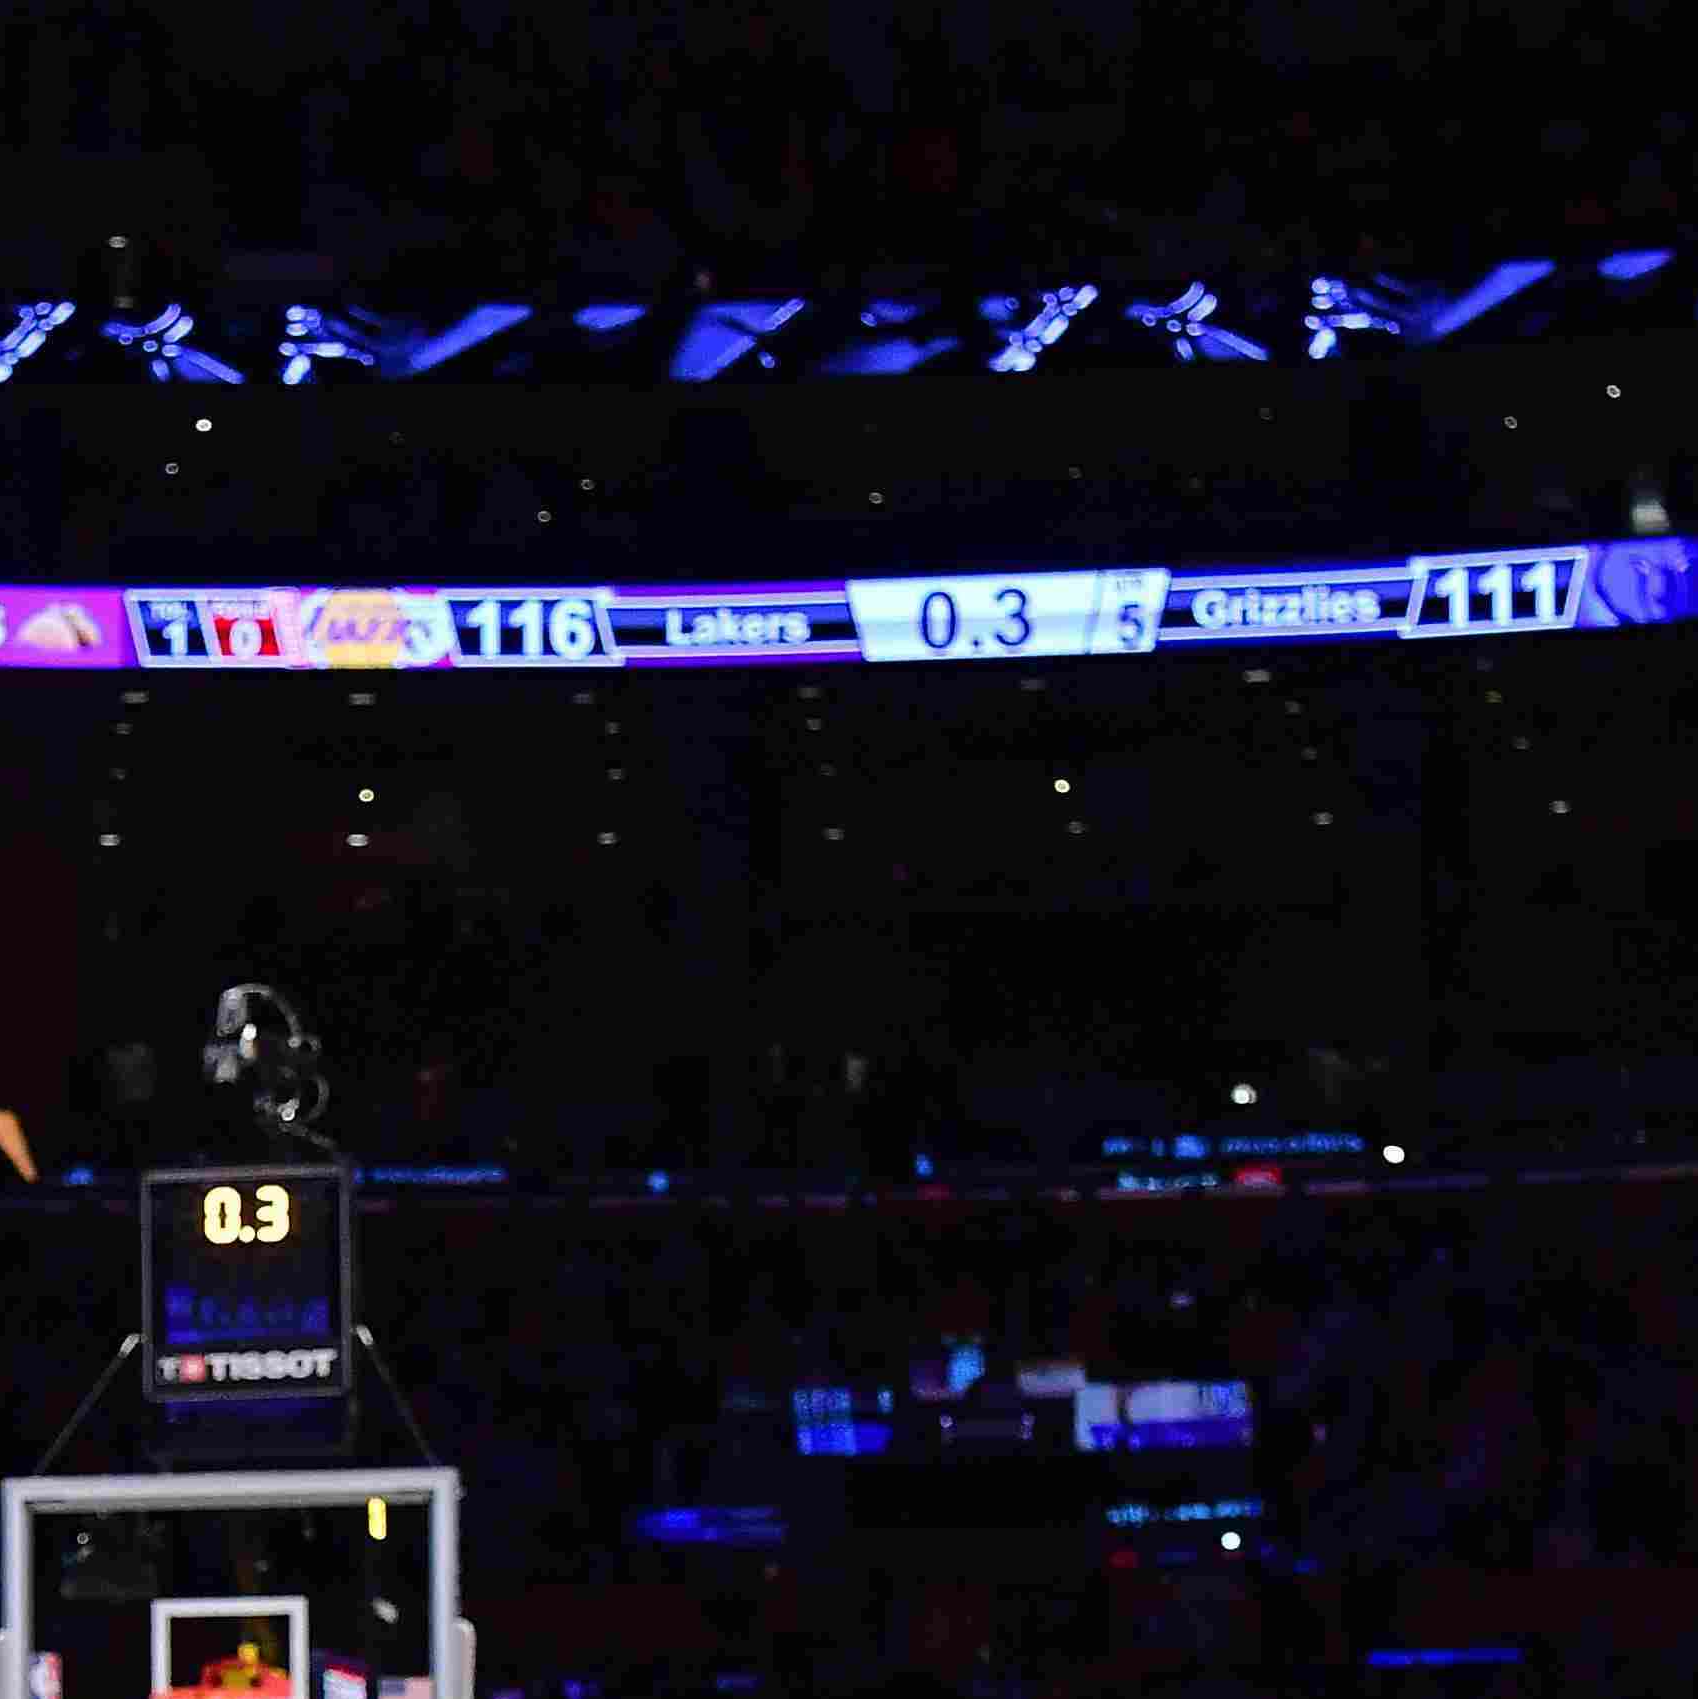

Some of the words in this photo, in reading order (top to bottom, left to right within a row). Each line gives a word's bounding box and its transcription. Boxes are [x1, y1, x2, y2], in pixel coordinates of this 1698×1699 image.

[918, 588, 1031, 650] 0.3
[1192, 587, 1381, 630] Grizzlies
[1434, 562, 1558, 628] 111
[162, 620, 189, 656] 1
[464, 600, 597, 660] 116
[664, 607, 812, 646] Lakers
[203, 1184, 290, 1245] 0.3
